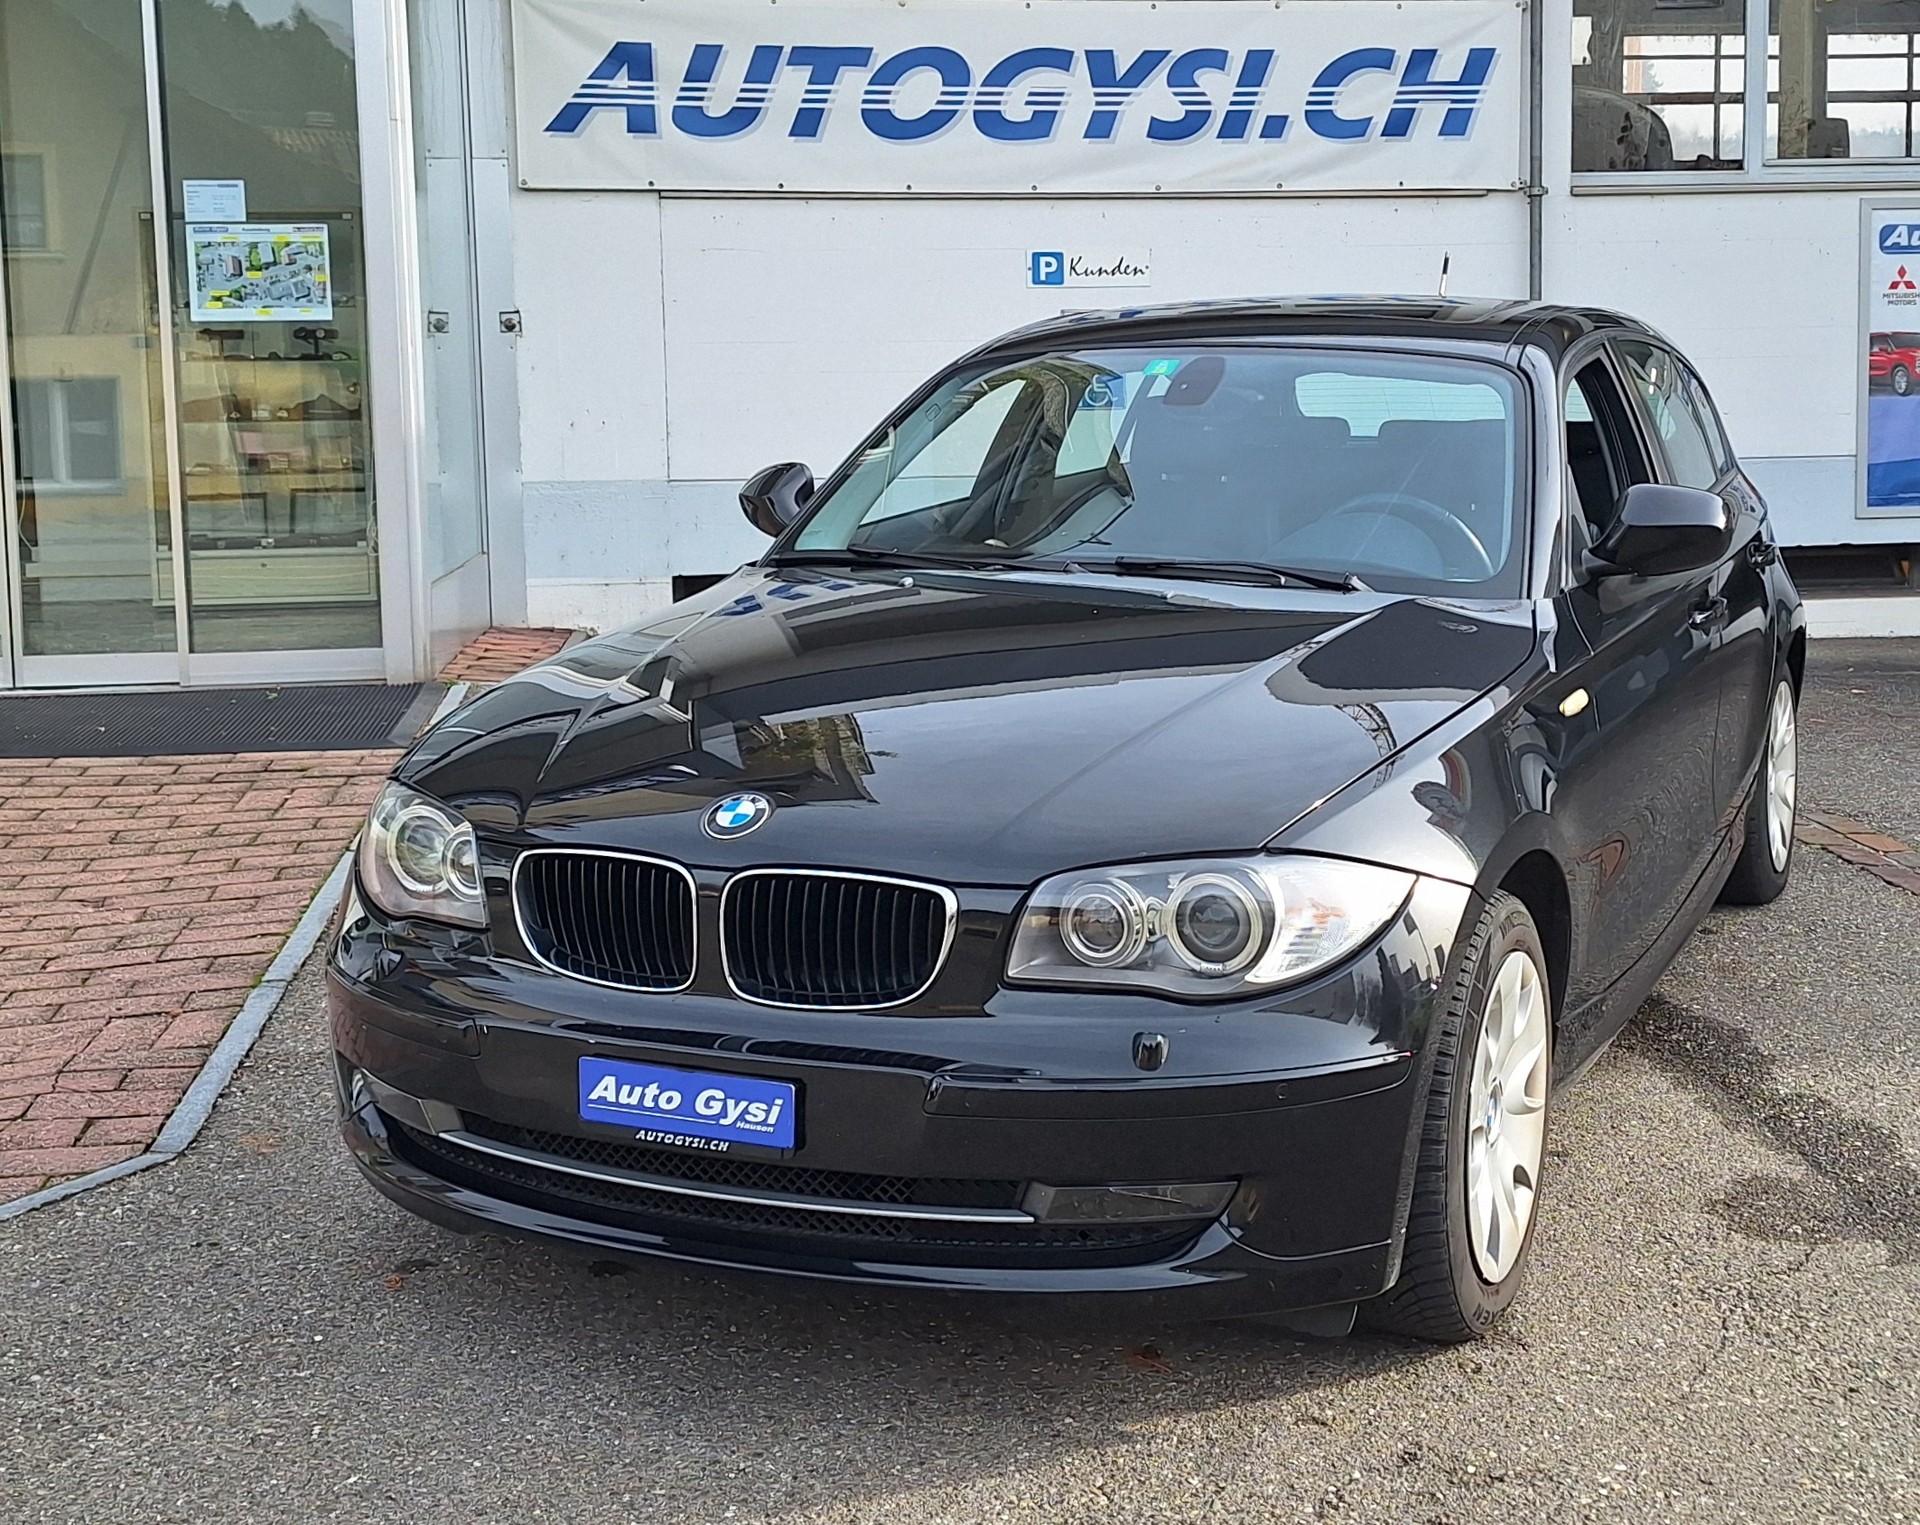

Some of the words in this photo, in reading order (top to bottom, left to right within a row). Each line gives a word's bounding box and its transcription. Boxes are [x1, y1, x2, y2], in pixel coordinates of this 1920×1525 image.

[543, 41, 1498, 142] AUTOGYSI.CH
[1039, 256, 1058, 281] P
[1069, 256, 1145, 277] Kunden
[588, 1075, 682, 1110] Auto
[694, 1088, 784, 1125] Gysi
[736, 1120, 774, 1133] Hausen
[635, 1129, 730, 1152] AUTOGYSI.CH
